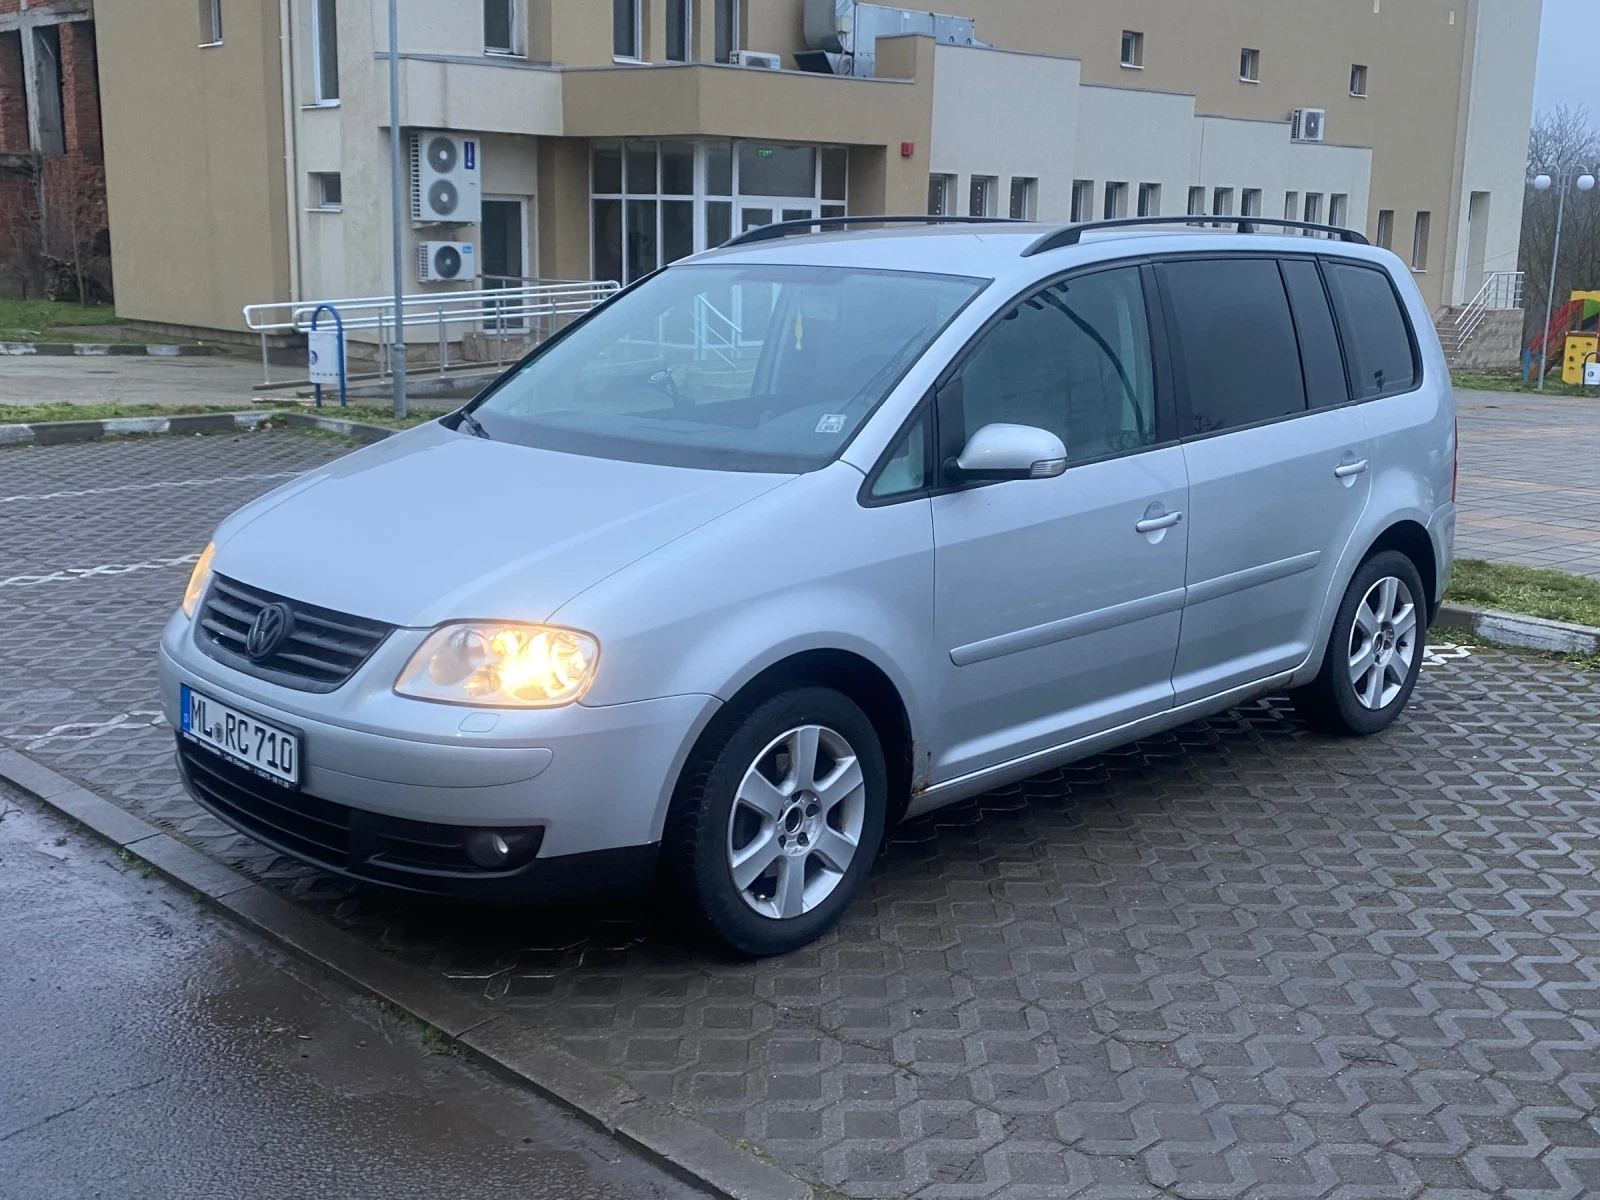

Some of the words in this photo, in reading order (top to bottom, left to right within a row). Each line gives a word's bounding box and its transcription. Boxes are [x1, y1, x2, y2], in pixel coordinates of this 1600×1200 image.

[191, 695, 213, 738] ML
[225, 712, 249, 755] RC
[254, 725, 293, 774] 710
